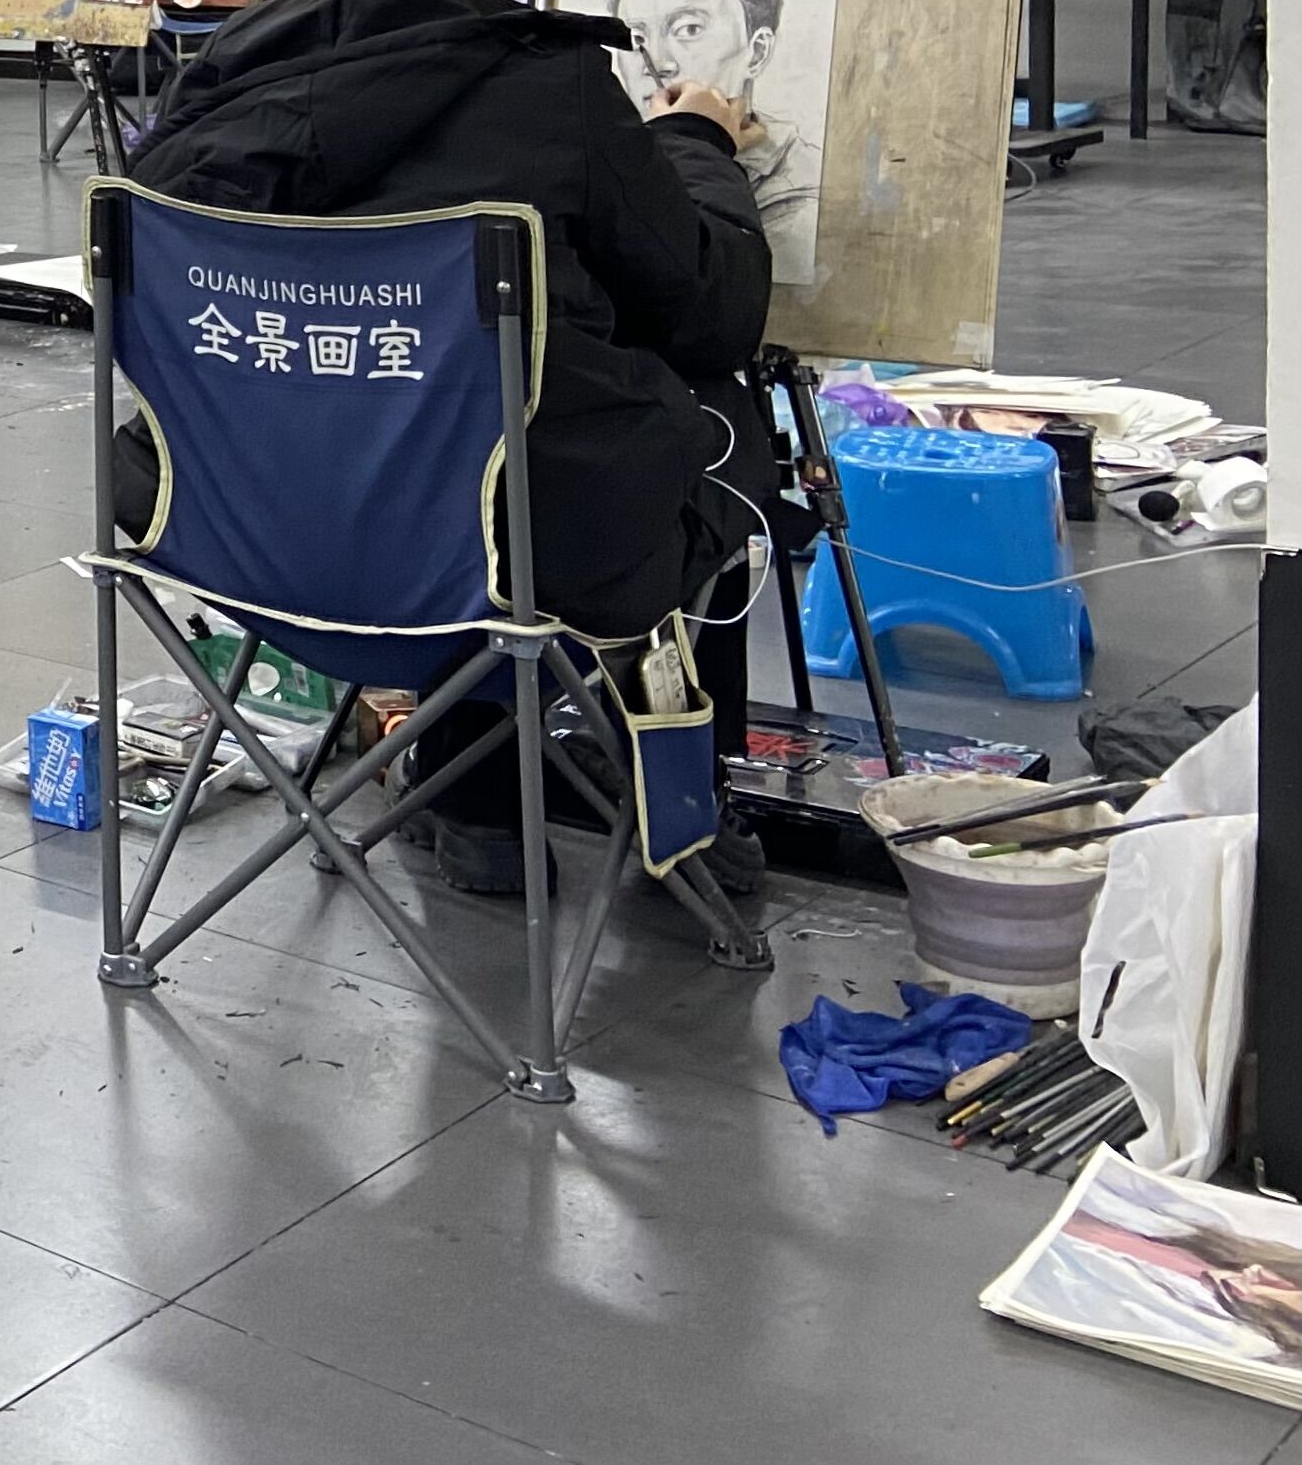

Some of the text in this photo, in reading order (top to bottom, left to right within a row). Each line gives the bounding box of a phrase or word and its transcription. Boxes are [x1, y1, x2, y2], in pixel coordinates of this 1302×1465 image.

[188, 266, 422, 307] QUANJINGHUASHI
[188, 303, 424, 381] 全景画室
